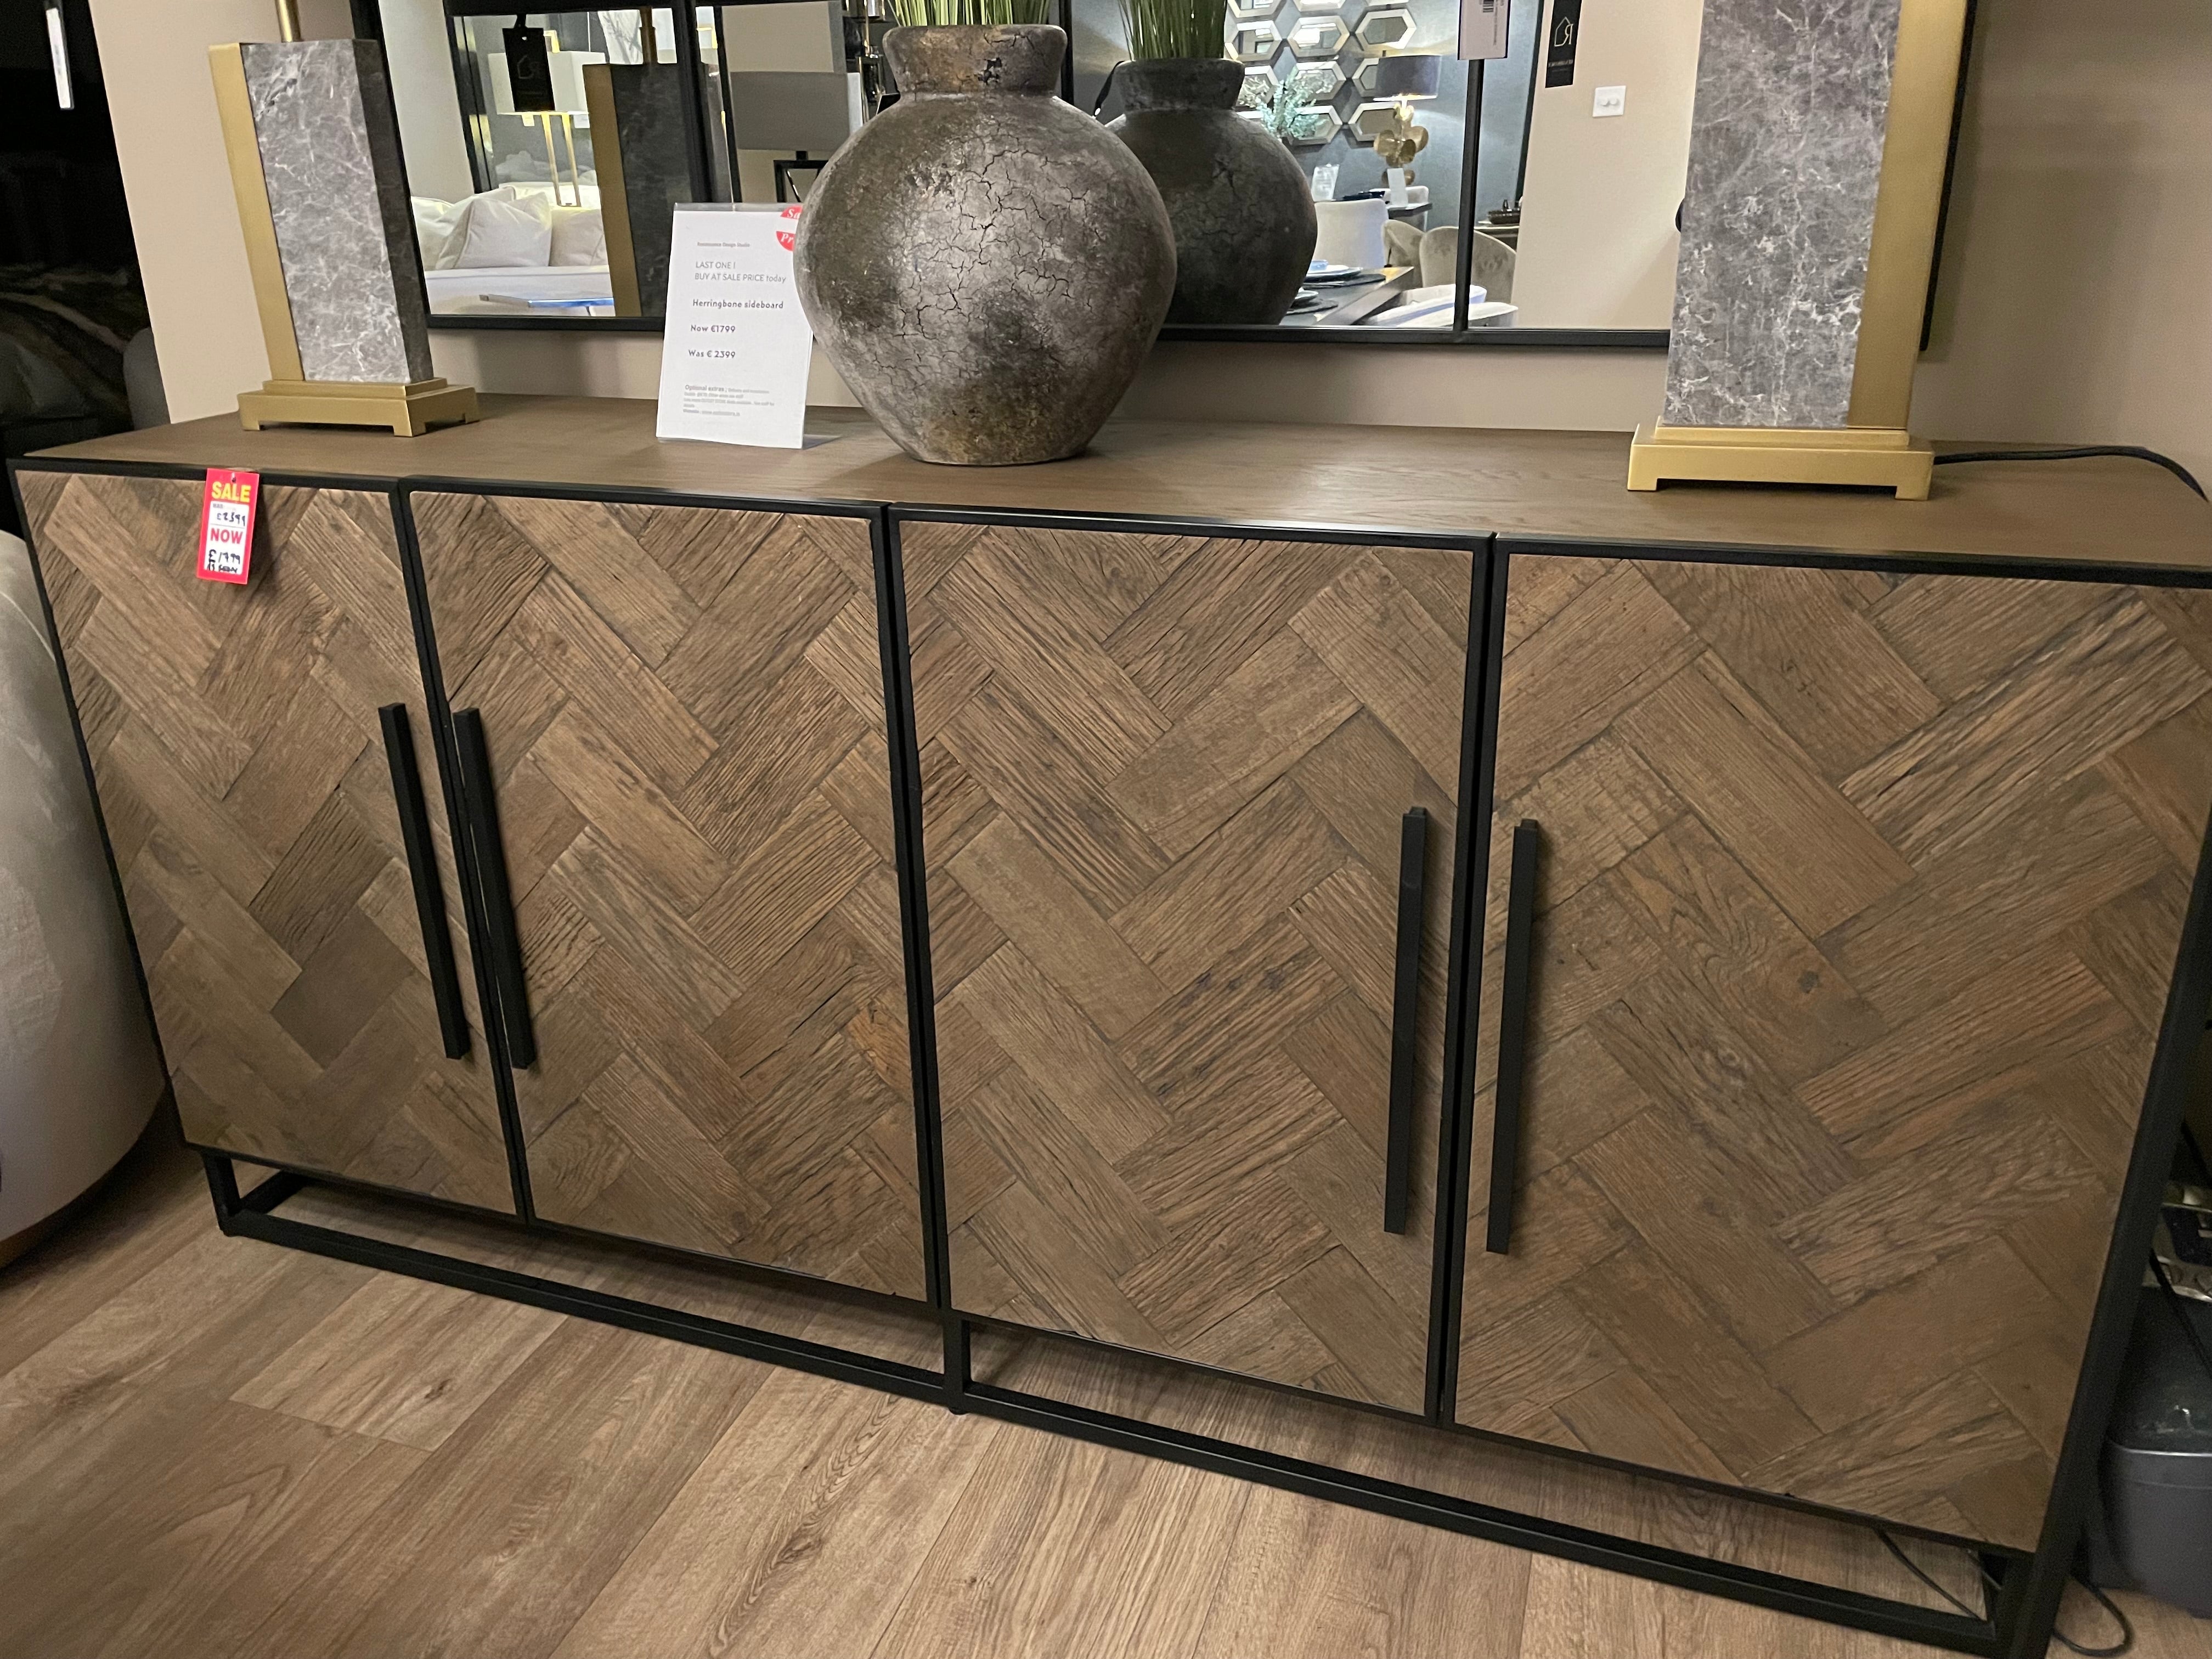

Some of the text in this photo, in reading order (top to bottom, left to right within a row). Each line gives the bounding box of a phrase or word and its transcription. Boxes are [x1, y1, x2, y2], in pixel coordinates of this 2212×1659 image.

[787, 208, 800, 219] Sa
[781, 233, 794, 243] Pr
[766, 275, 786, 284] today
[693, 299, 783, 309] Herringbone sideboard
[211, 481, 251, 503] SALE
[210, 528, 243, 544] NOW
